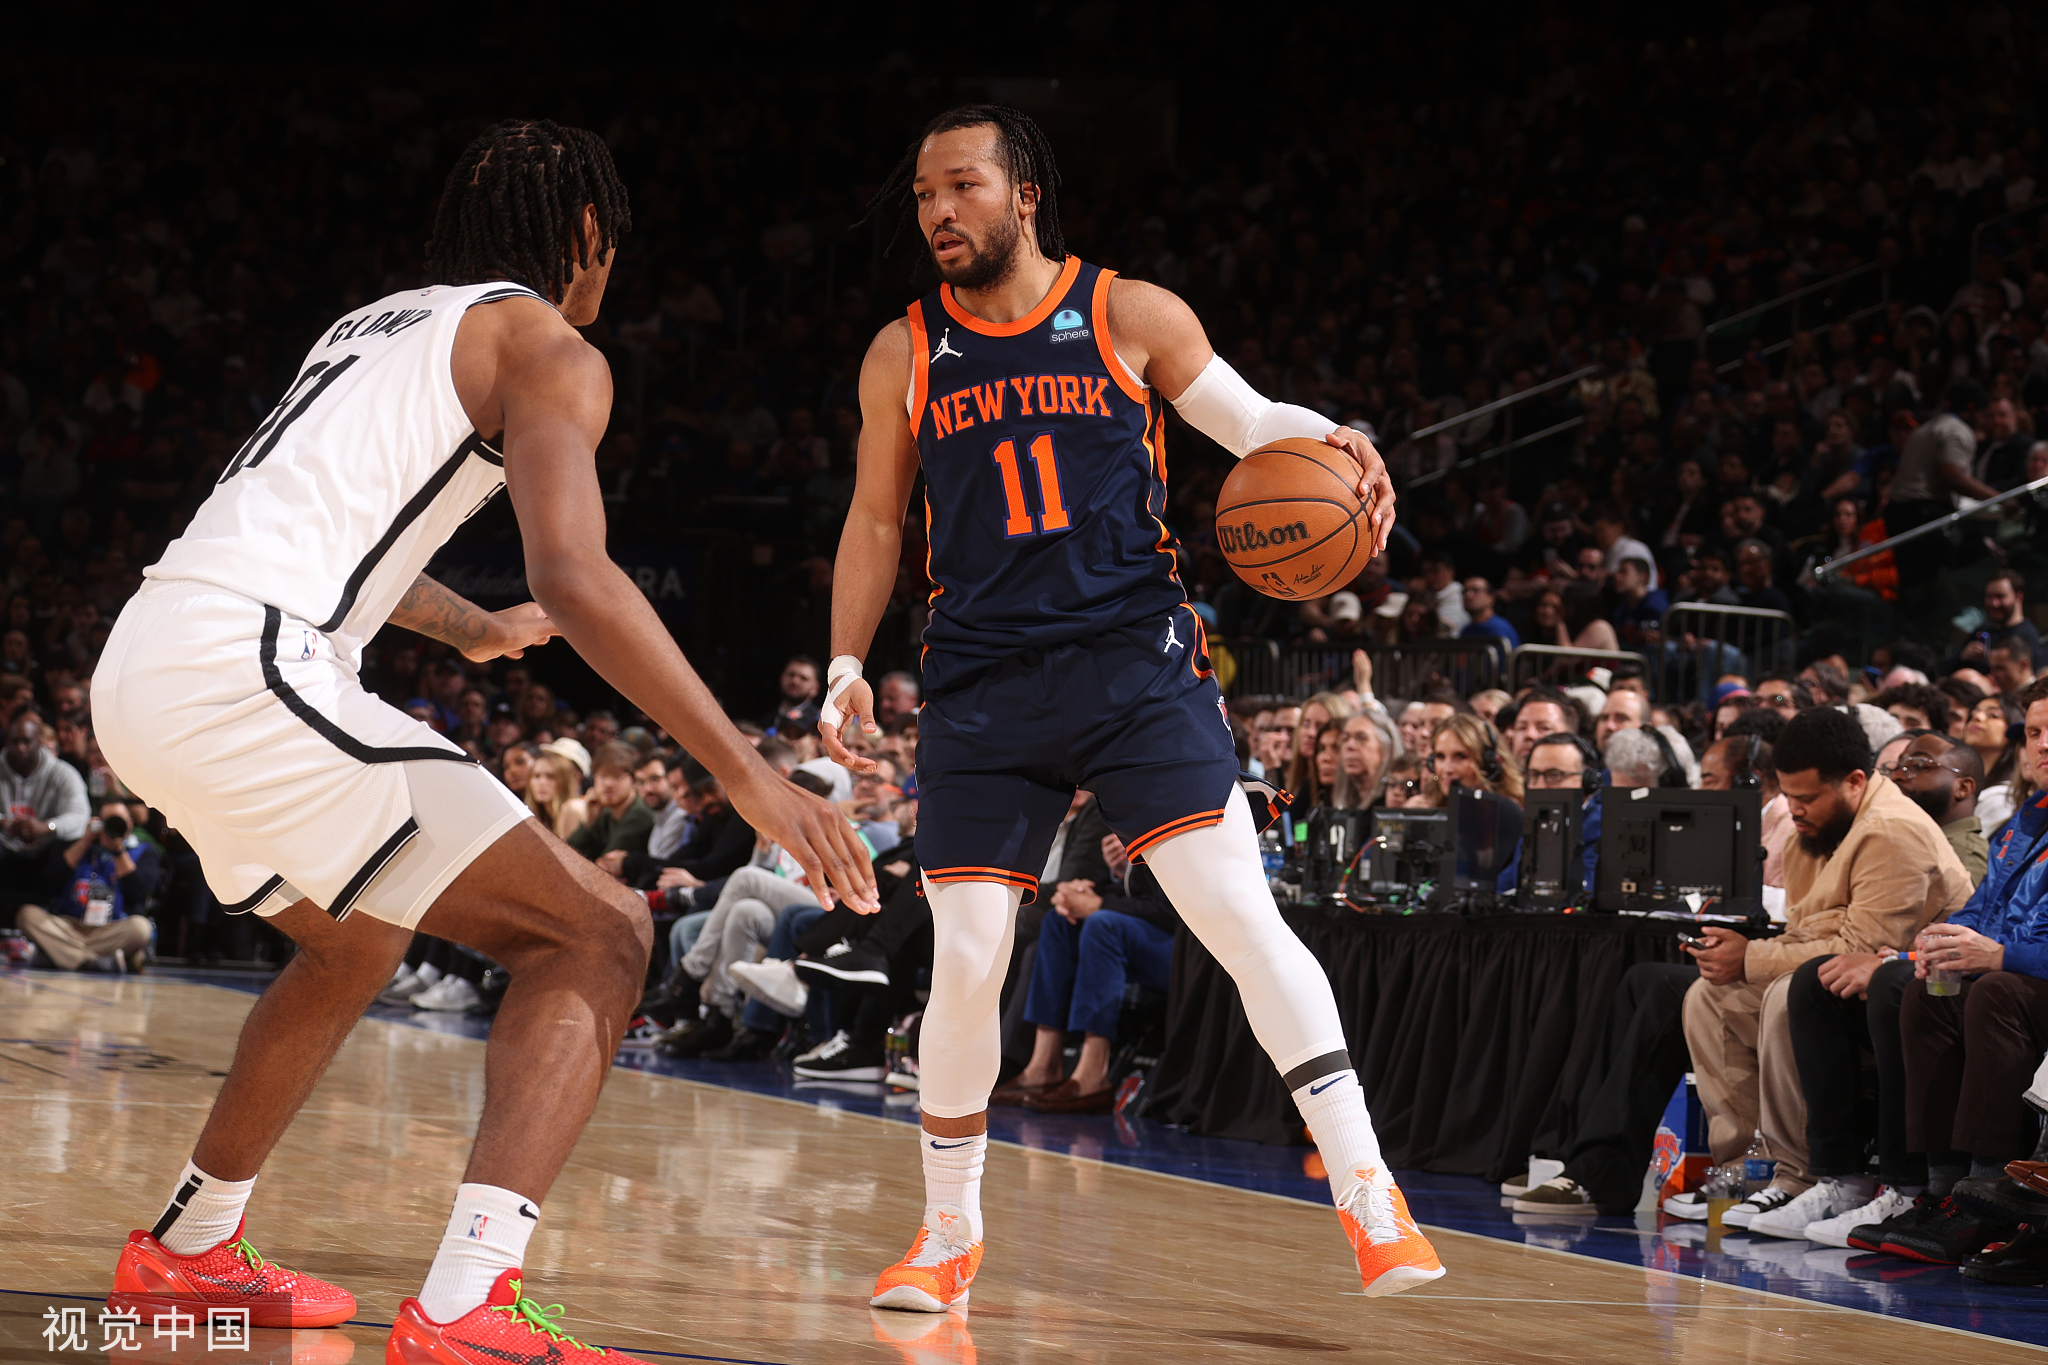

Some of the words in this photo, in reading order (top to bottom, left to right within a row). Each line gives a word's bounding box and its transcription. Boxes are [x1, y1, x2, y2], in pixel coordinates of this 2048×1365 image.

[1051, 329, 1089, 343] sphere
[930, 377, 1006, 441] NEW
[1010, 373, 1114, 420] YORK
[990, 430, 1074, 539] 11
[1218, 521, 1311, 554] Wilson
